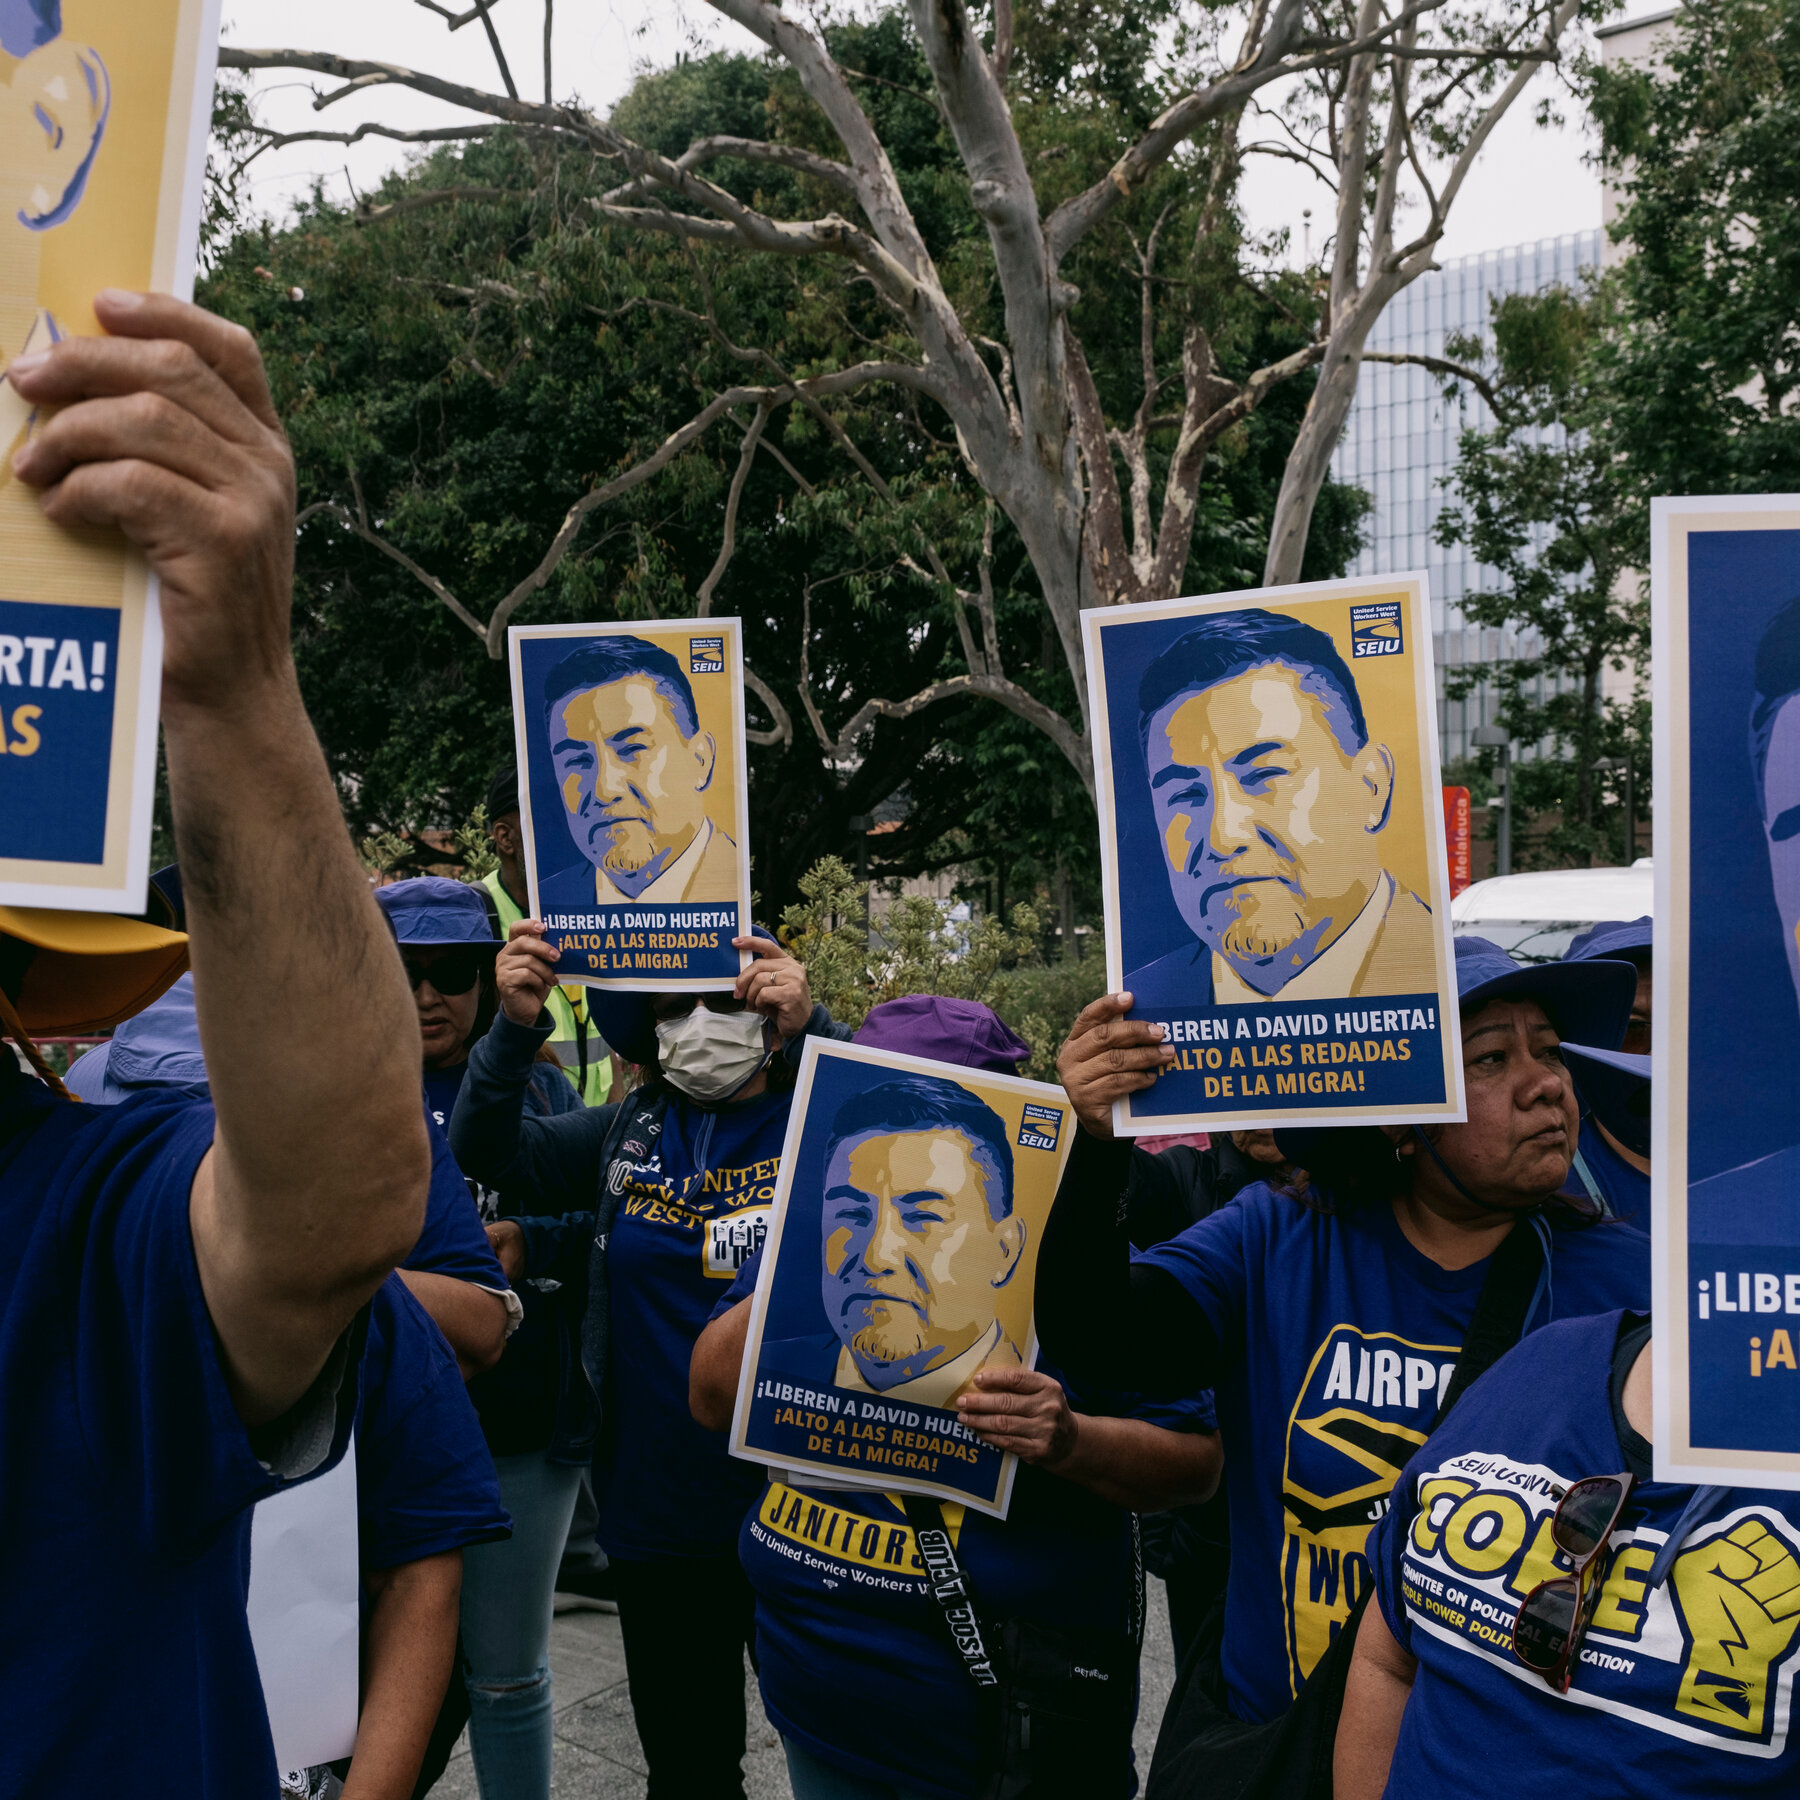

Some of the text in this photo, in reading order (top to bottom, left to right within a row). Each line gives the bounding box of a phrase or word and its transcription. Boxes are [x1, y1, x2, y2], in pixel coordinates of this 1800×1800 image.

[1355, 639, 1400, 656] SEIU
[692, 662, 722, 672] SEIU
[543, 912, 735, 931] ¡LIBEREN A DAVID HUERTA!
[559, 932, 719, 952] ¡ALTO A LAS REDADAS
[588, 953, 688, 969] DE LA MIGRA!
[1235, 1018, 1251, 1039] A
[1256, 1013, 1328, 1038] DAVID
[1334, 1007, 1436, 1034] HUERTA!
[1229, 1047, 1246, 1068] A
[1251, 1044, 1293, 1067] LAS
[1301, 1038, 1411, 1065] REDADAS
[1203, 1070, 1366, 1098] DE LA MIGRA!
[1019, 1133, 1055, 1149] SEIU
[624, 1195, 703, 1229] WEST
[757, 1380, 840, 1413] ¡LIBEREN
[843, 1400, 857, 1417] A
[861, 1402, 920, 1428] DAVID
[774, 1407, 979, 1464] ¡ALTO A LAS REDADAS
[807, 1434, 938, 1473] DE LA MIGRA!
[750, 1521, 766, 1542] SEIU
[766, 1535, 802, 1562] United
[804, 1553, 848, 1578] Service
[850, 1568, 913, 1594] Workers
[1425, 1597, 1466, 1628] POWER
[1446, 1588, 1468, 1608] ON
